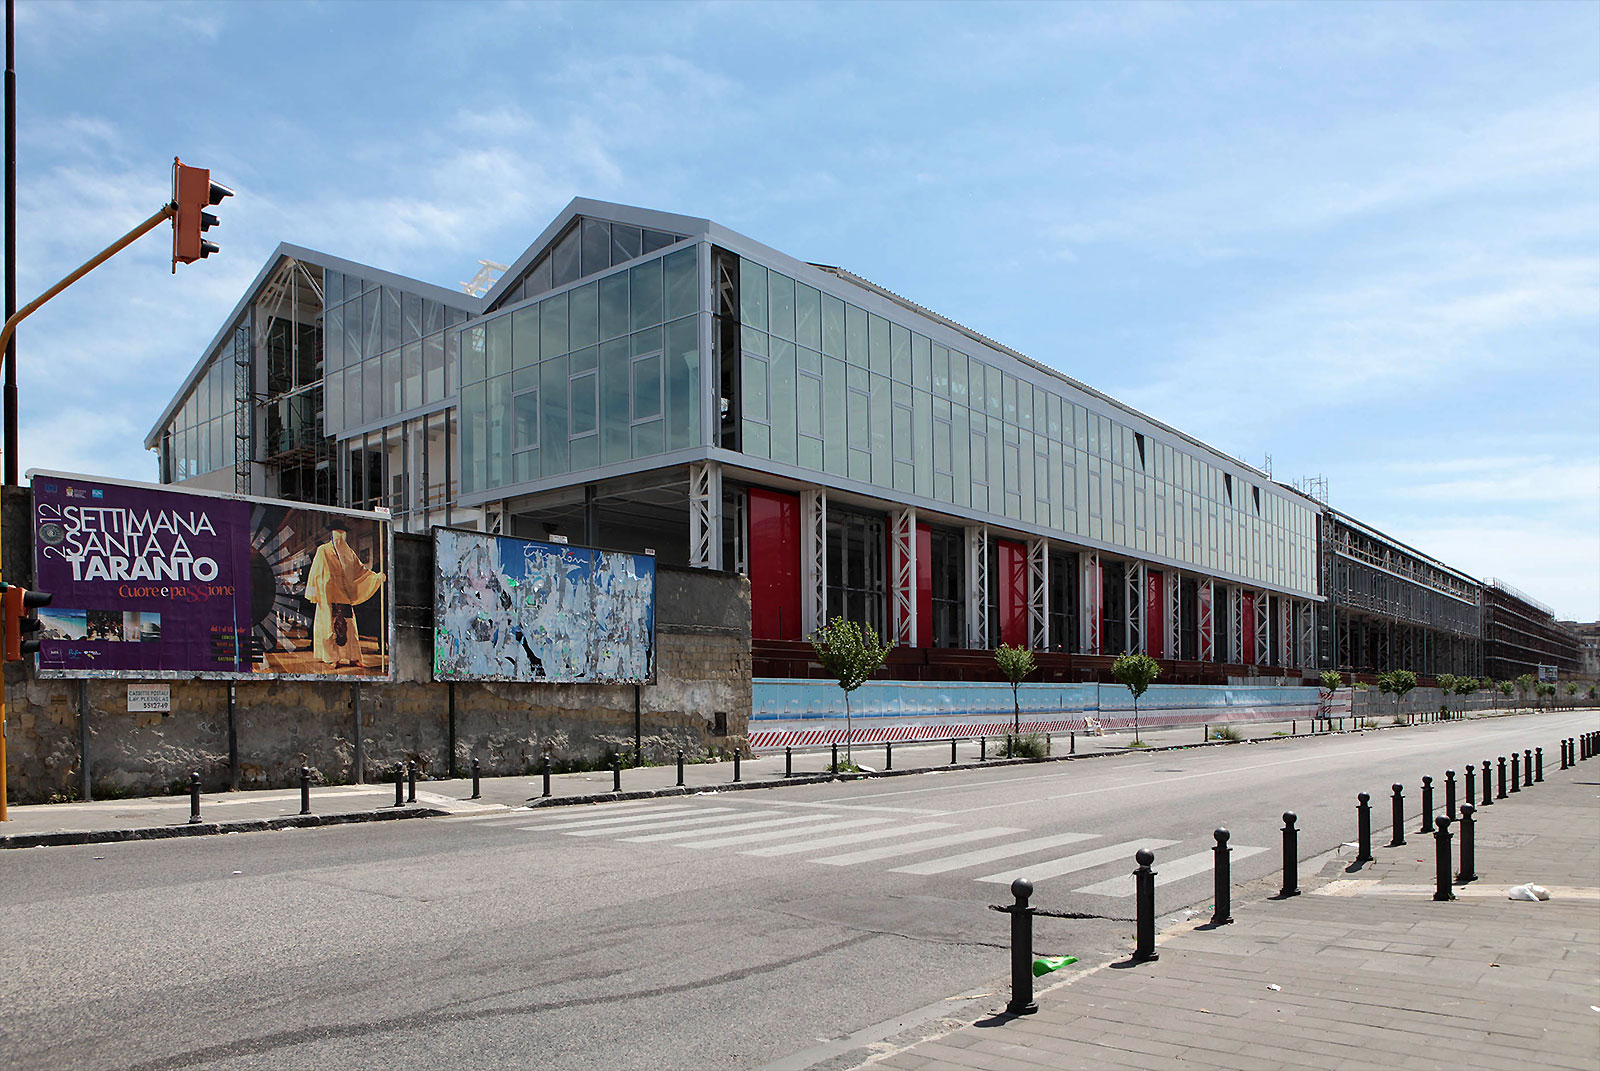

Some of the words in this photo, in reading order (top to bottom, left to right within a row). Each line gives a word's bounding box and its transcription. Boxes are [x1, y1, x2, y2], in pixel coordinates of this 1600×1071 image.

[63, 505, 217, 537] SETTIMANA
[65, 530, 166, 557] SANTA
[170, 533, 193, 558] A
[65, 555, 219, 582] TARANTO
